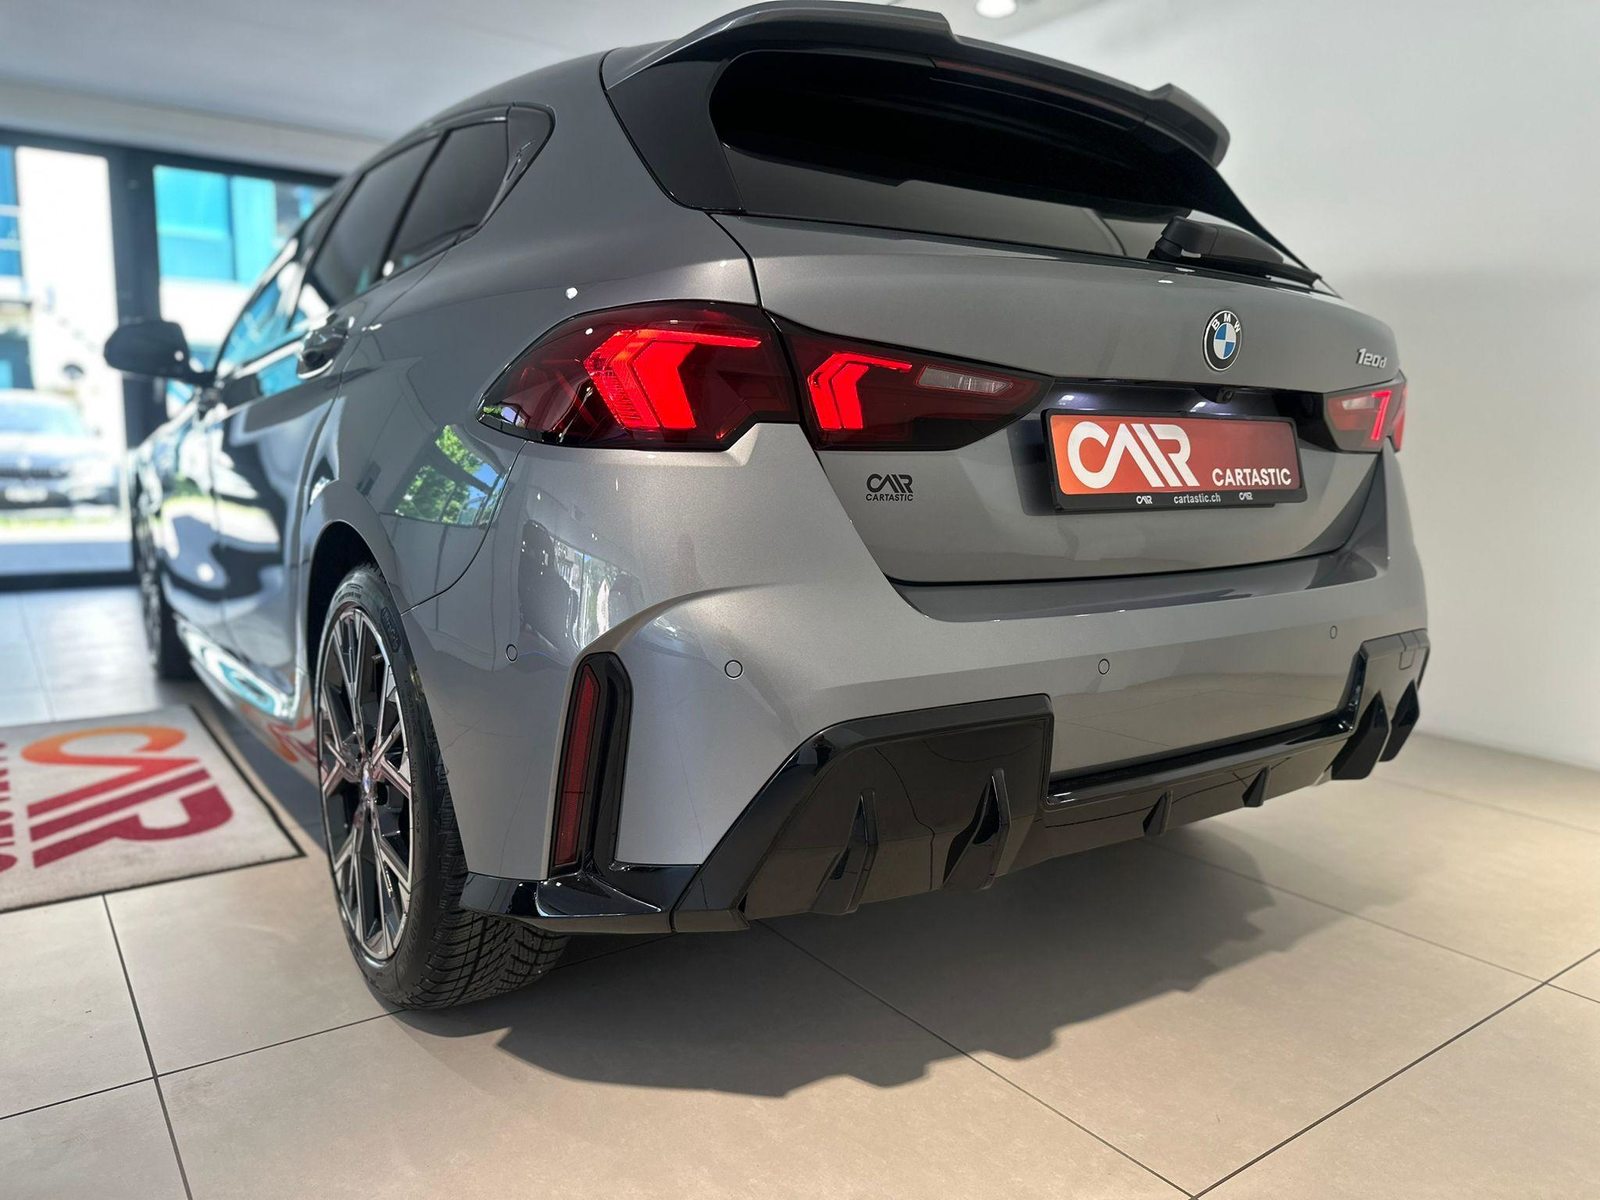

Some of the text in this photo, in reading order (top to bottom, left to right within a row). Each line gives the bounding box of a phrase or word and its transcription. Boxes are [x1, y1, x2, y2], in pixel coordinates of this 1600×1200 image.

[1211, 312, 1241, 333] BMW
[1356, 347, 1388, 369] 120d
[1211, 467, 1292, 487] CARTASTIC
[865, 493, 914, 502] CARTASTIC
[1173, 492, 1222, 504] cartastic.ch
